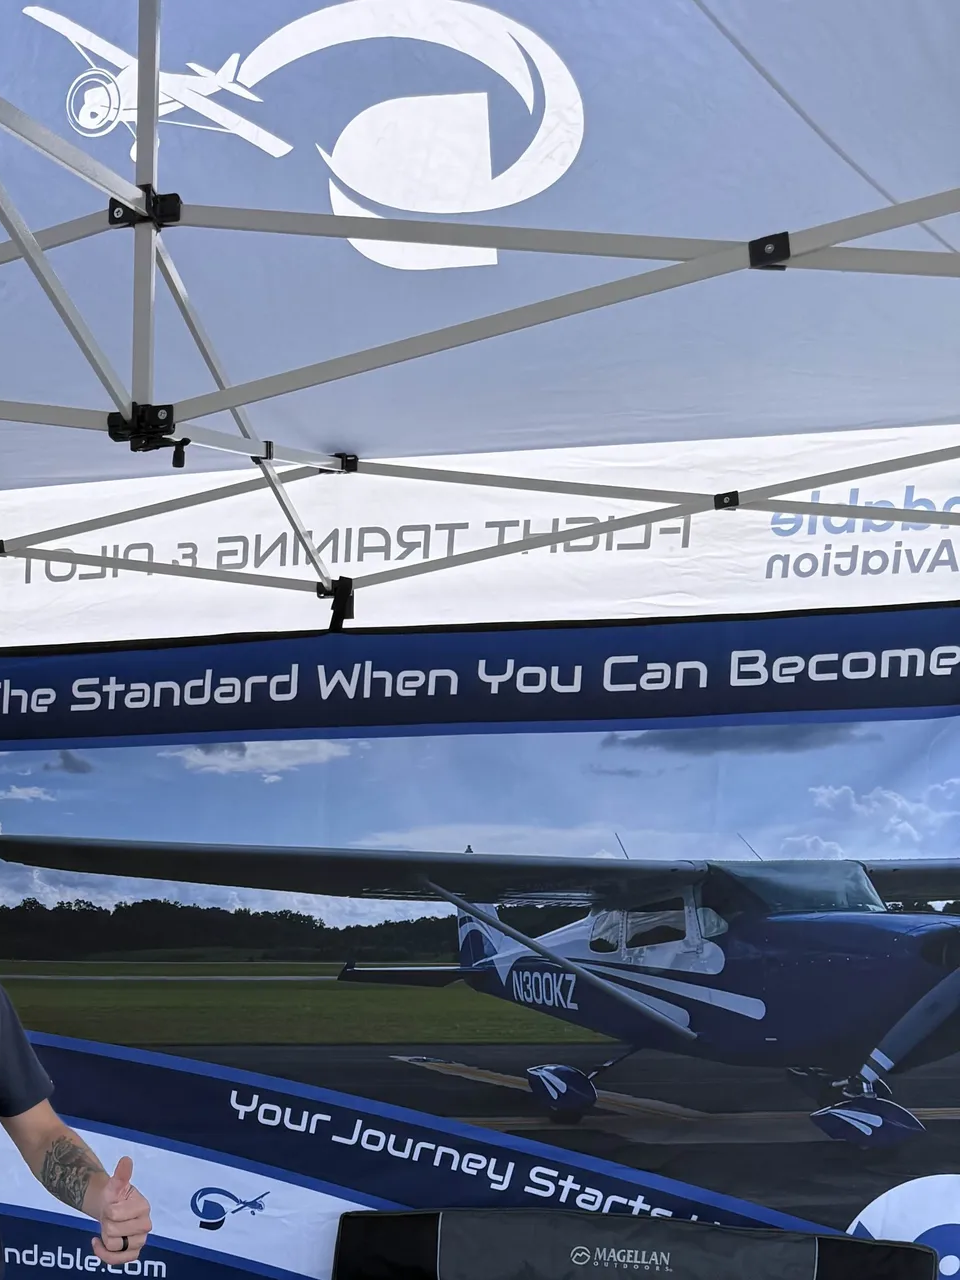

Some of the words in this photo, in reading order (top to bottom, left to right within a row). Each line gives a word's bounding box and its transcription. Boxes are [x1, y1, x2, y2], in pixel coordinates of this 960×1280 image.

[70, 663, 299, 711] Standard
[317, 660, 459, 700] When
[476, 658, 583, 695] You
[602, 654, 708, 693] Can
[730, 645, 960, 687] Become
[511, 969, 580, 1012] N300KZ
[228, 1089, 332, 1139] Your
[331, 1116, 515, 1191] Journey
[593, 1247, 671, 1266] MAGELLAN
[593, 1260, 672, 1273] OUTDOORS
